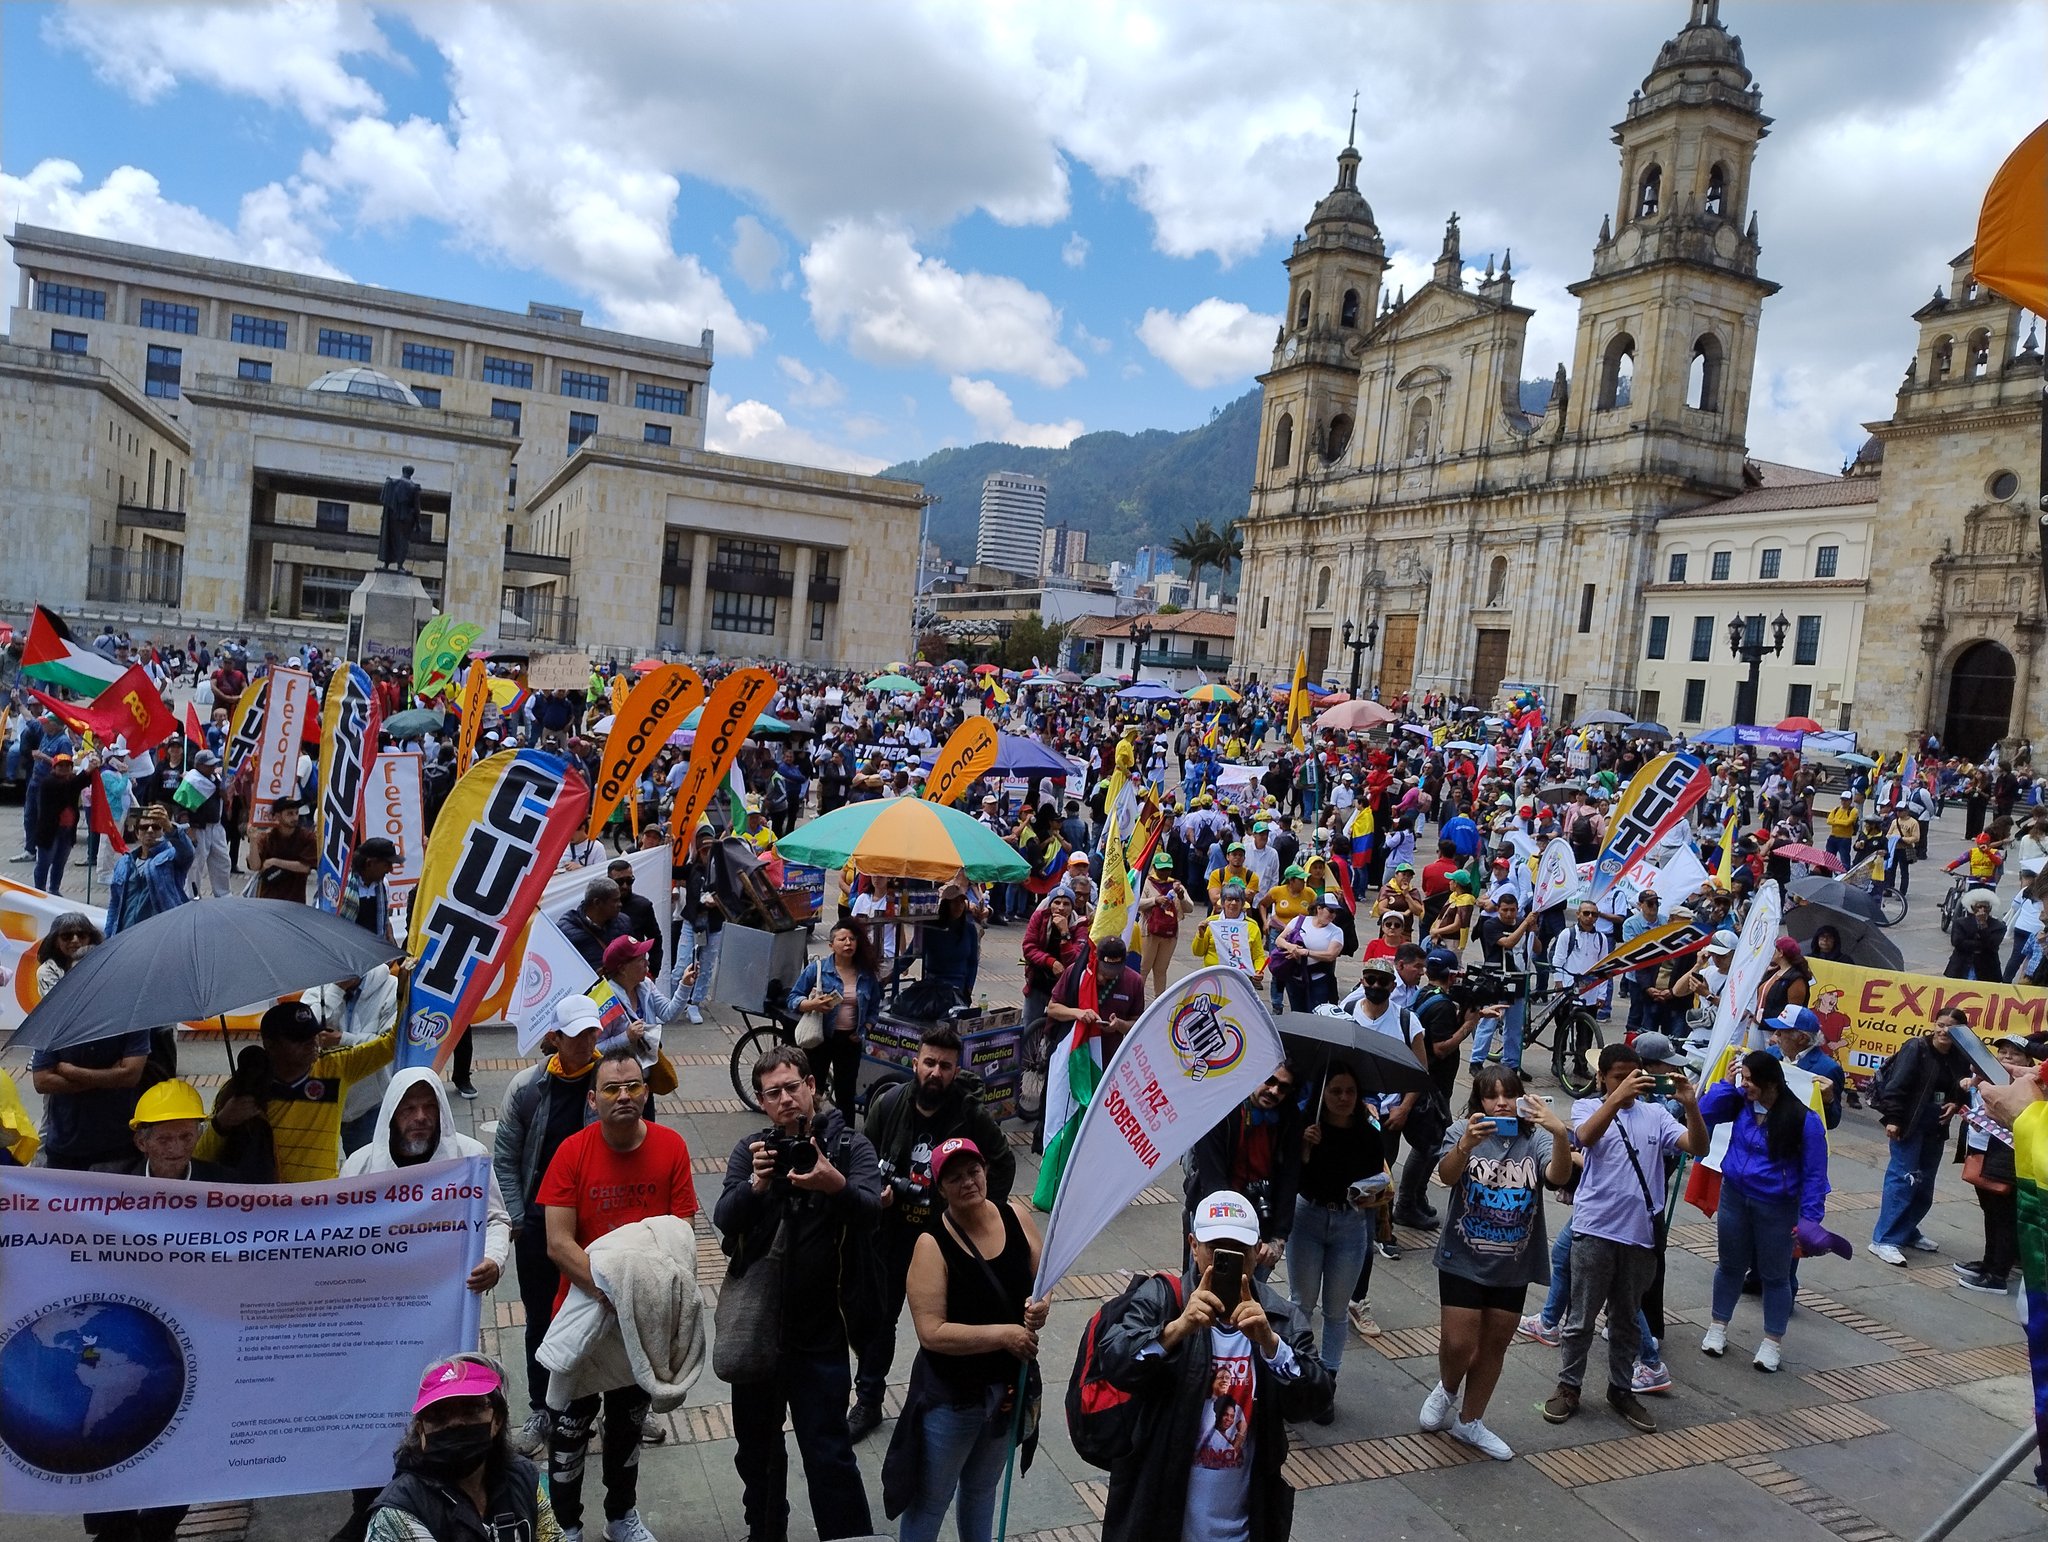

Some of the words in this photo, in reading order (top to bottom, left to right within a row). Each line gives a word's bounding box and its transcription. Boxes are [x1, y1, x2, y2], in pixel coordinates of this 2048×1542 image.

[460, 673, 484, 773] fecod
[270, 679, 297, 794] fecode
[601, 679, 692, 802] fecode
[928, 737, 992, 803] fecod
[1614, 760, 1695, 856] CUT
[422, 764, 559, 996] CUT
[1859, 979, 2047, 1033] EXIGIM
[1858, 1017, 1897, 1034] vida
[869, 1033, 897, 1046] omática
[901, 1037, 919, 1050] Cane
[1859, 1040, 1883, 1052] POR
[972, 1048, 1013, 1063] Aromática
[983, 1087, 1012, 1102] nelazo
[1142, 1079, 1169, 1115] PAZ
[1104, 1089, 1161, 1170] SOBERANIA
[0, 1194, 39, 1211] eliz
[47, 1190, 198, 1215] cumpleaños
[301, 1194, 328, 1206] en
[337, 1190, 377, 1204] sus
[384, 1184, 424, 1203] 486
[431, 1183, 484, 1201] años
[590, 1183, 656, 1199] CHICAGO
[0, 1232, 88, 1247] MBAJADA
[93, 1233, 117, 1246] DE
[122, 1233, 158, 1246] LOS
[163, 1230, 248, 1246] PUEBLOS
[253, 1229, 289, 1243] POR
[294, 1227, 316, 1242] LA
[321, 1226, 354, 1241] PAZ
[359, 1225, 382, 1239] DE
[388, 1219, 468, 1236] COLOMBIA
[473, 1220, 484, 1232] Y
[70, 1250, 93, 1262] EL
[98, 1250, 164, 1263] MUNDO
[169, 1251, 206, 1263] POR
[211, 1251, 233, 1263] EL
[238, 1245, 366, 1262] BICENTENARIO
[371, 1241, 408, 1256] ONG
[314, 1278, 367, 1288] CONVOCATORIA
[63, 1291, 127, 1308] PUEBLOS
[127, 1295, 153, 1313] POR
[34, 1300, 62, 1318] LOS
[152, 1306, 168, 1322] LA
[15, 1312, 34, 1330] DE
[166, 1316, 187, 1339] PAZ
[180, 1336, 195, 1354] DE
[180, 1352, 199, 1414] COLOMBIA
[258, 1417, 291, 1426] REGIONAL
[304, 1414, 338, 1422] COLOMBIA
[354, 1411, 385, 1419] ENFOQUE
[386, 1410, 413, 1418] TERRITO
[159, 1425, 178, 1440] EL
[230, 1430, 267, 1439] EMBAJADA
[279, 1427, 293, 1435] LOS
[294, 1425, 325, 1434] PUEBLOS
[229, 1437, 255, 1446] MUNDO
[115, 1437, 164, 1474] MUNDO
[228, 1454, 287, 1468] Voluntariado
[67, 1475, 82, 1486] EL
[85, 1470, 115, 1484] POR
